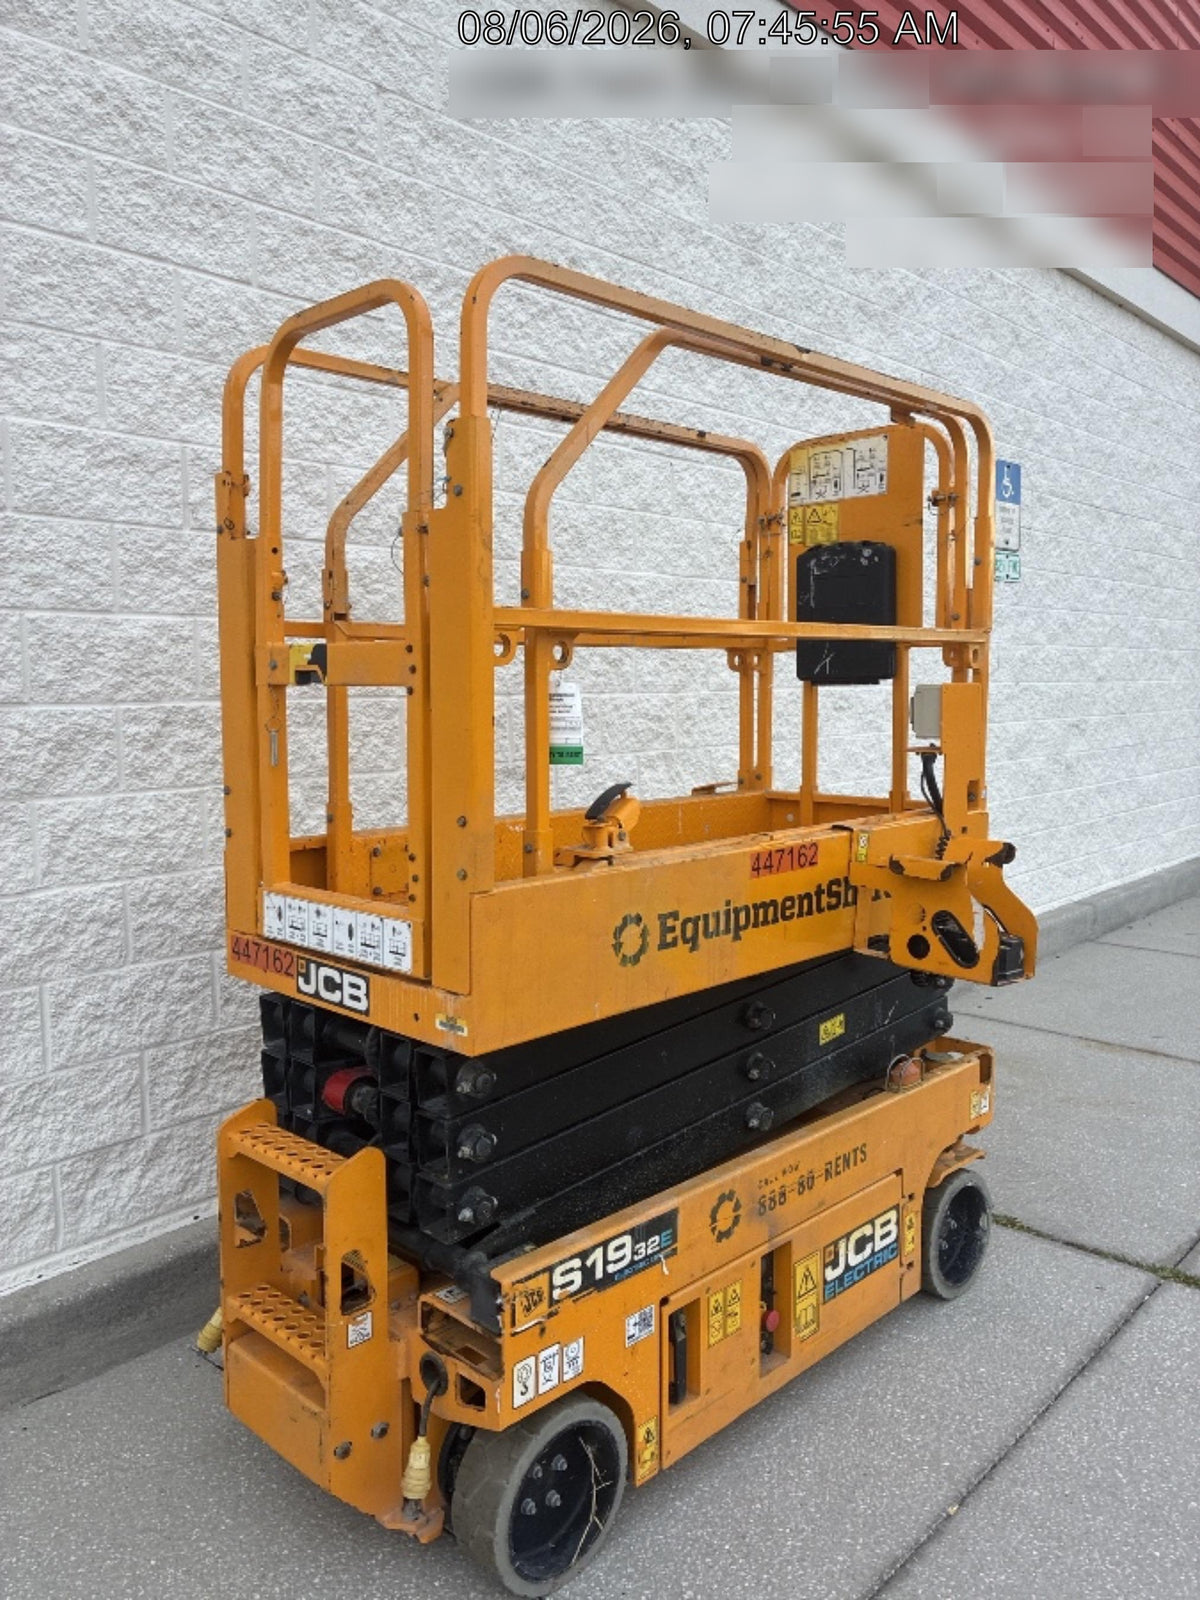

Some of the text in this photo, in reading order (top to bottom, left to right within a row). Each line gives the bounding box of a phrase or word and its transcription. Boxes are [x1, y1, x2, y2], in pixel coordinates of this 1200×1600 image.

[751, 842, 819, 876] 447162
[657, 876, 892, 953] EquipmentSh
[232, 936, 294, 977] 447162
[298, 960, 368, 1012] JCB
[824, 1243, 898, 1301] ELECTRIC
[825, 1209, 898, 1282] JCB
